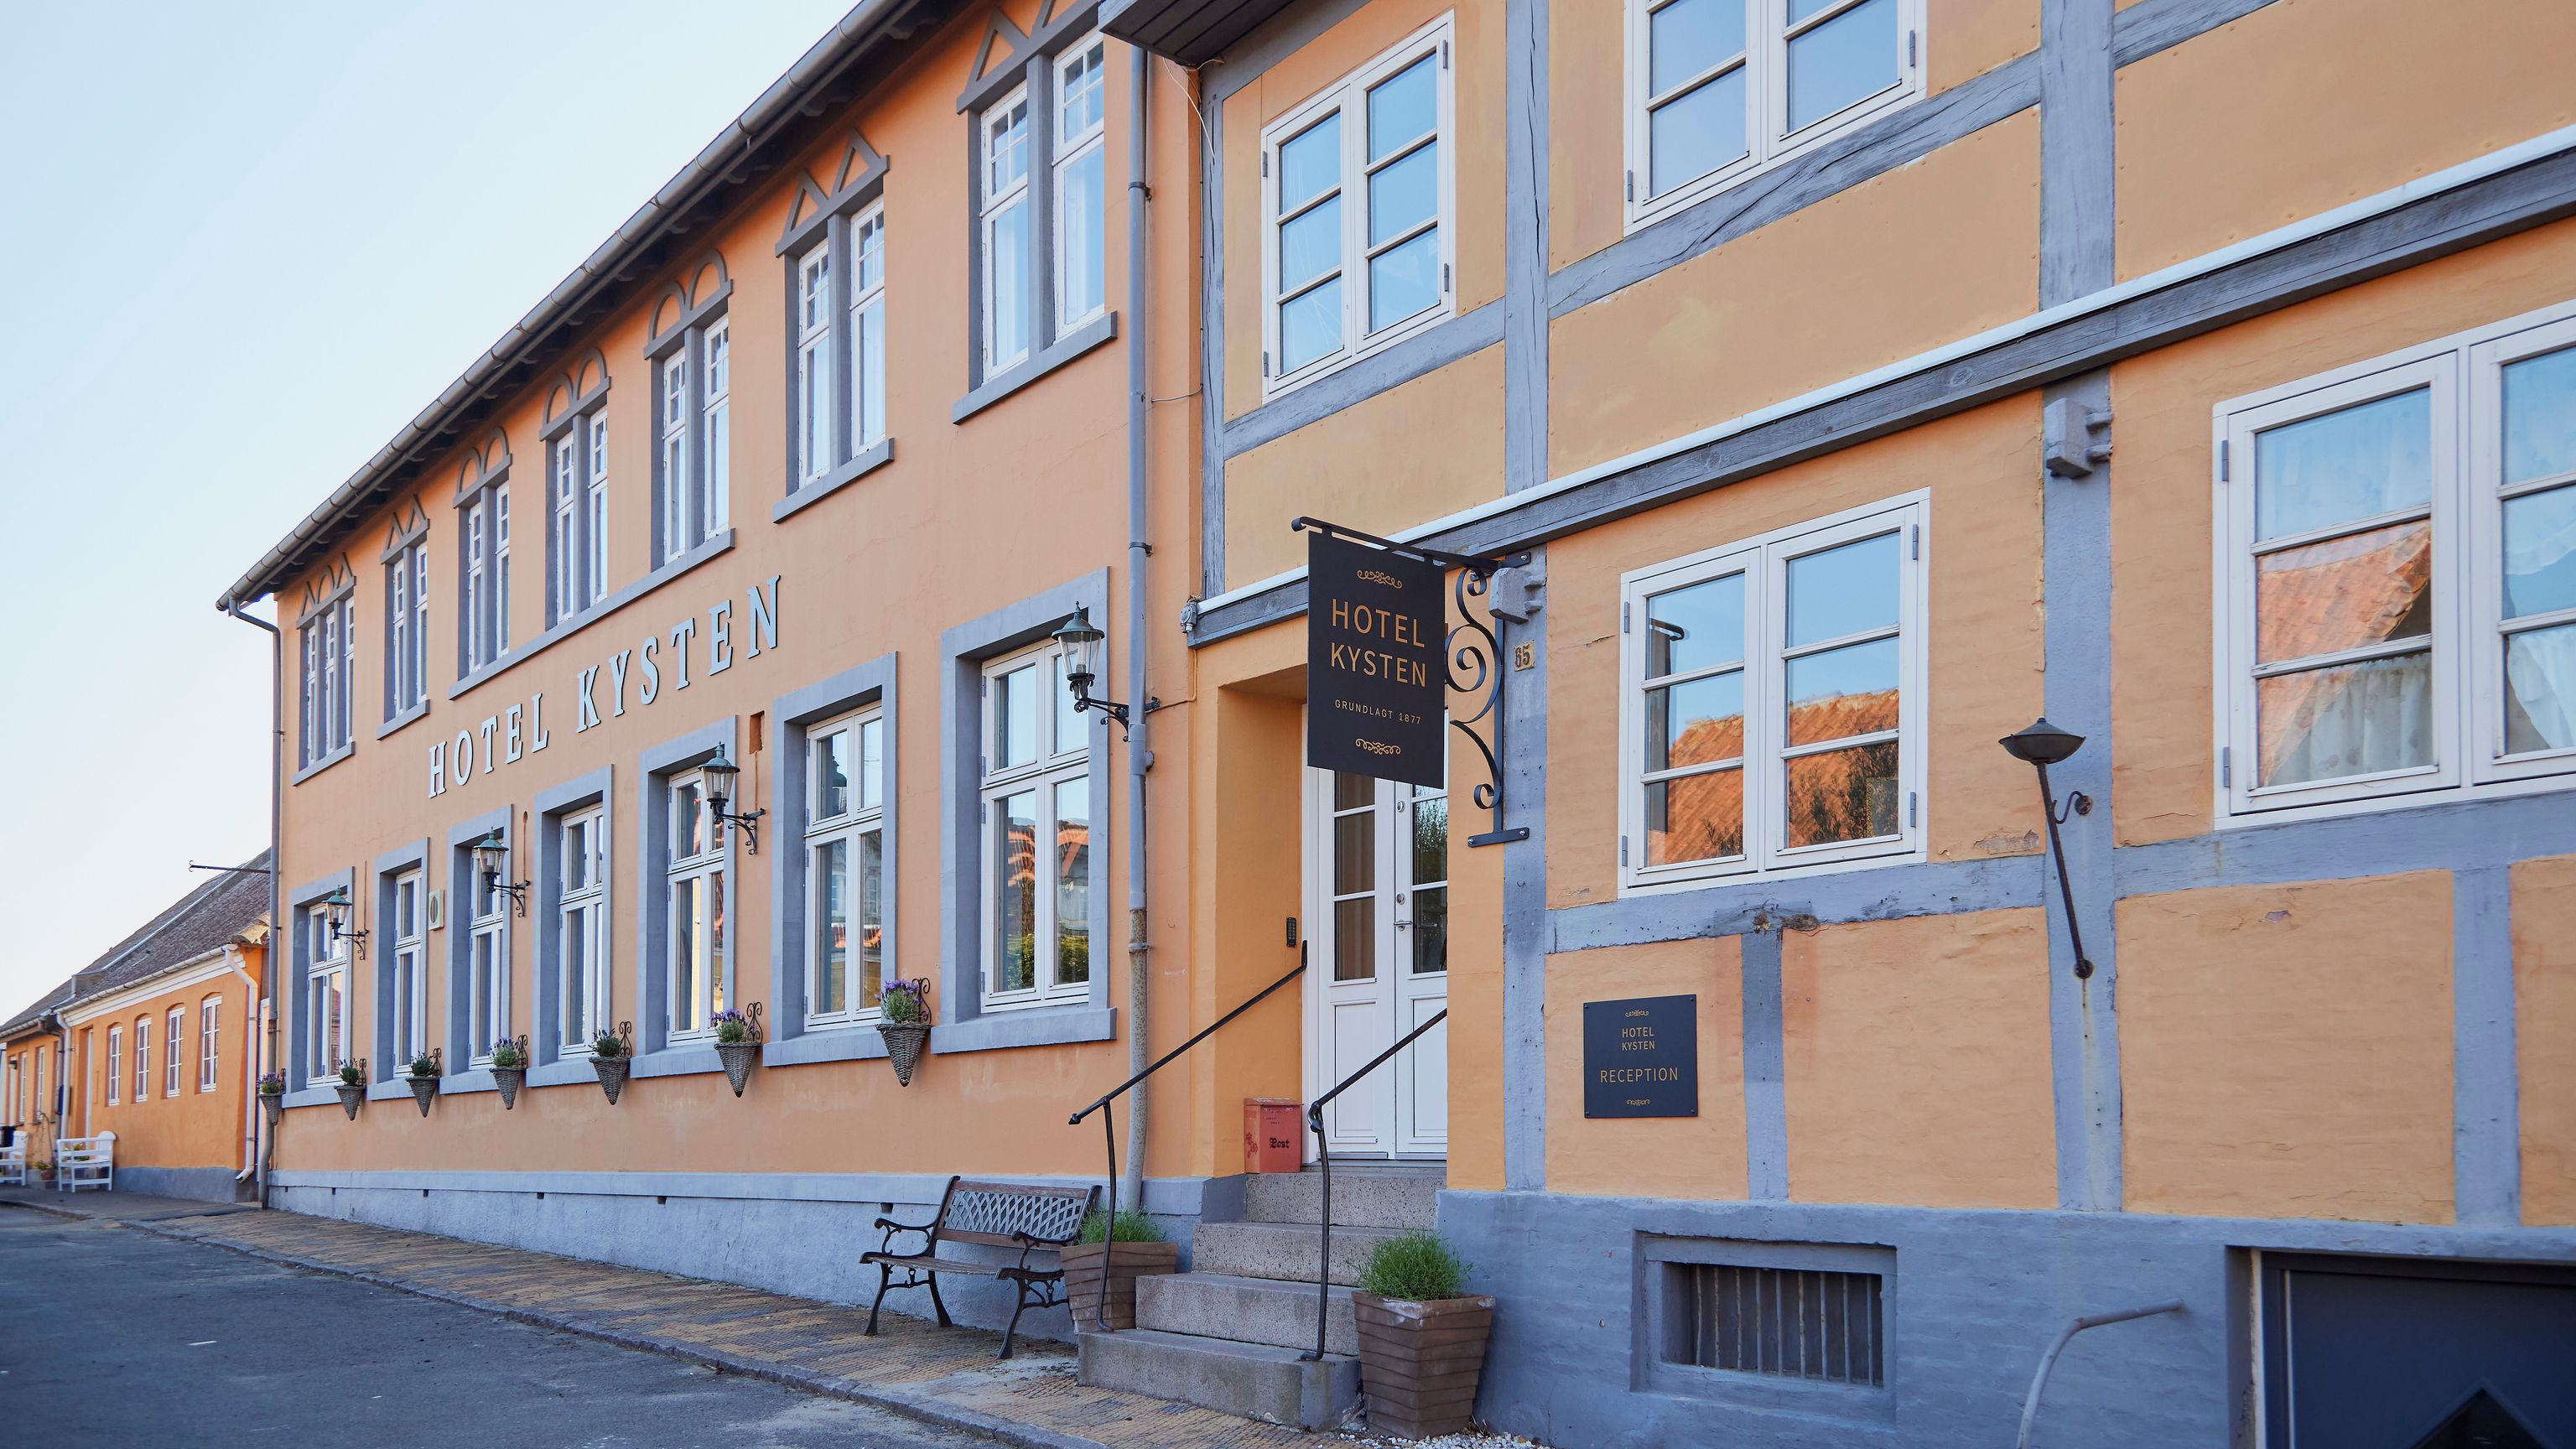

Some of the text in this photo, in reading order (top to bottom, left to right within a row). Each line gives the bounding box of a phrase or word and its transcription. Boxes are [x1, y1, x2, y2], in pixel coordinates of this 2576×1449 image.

[1332, 598, 1426, 648] HOTEL
[1330, 642, 1426, 688] KYSTEN
[1514, 644, 1530, 667] 65
[428, 574, 782, 798] HOTEL KYSTEN
[1335, 699, 1421, 724] GRUNDLAGT 1877
[1622, 1026, 1654, 1038] HOTEL
[1622, 1041, 1655, 1051] KYSTEN
[1600, 1067, 1678, 1083] RECEPTION
[1269, 1137, 1290, 1149] Post
